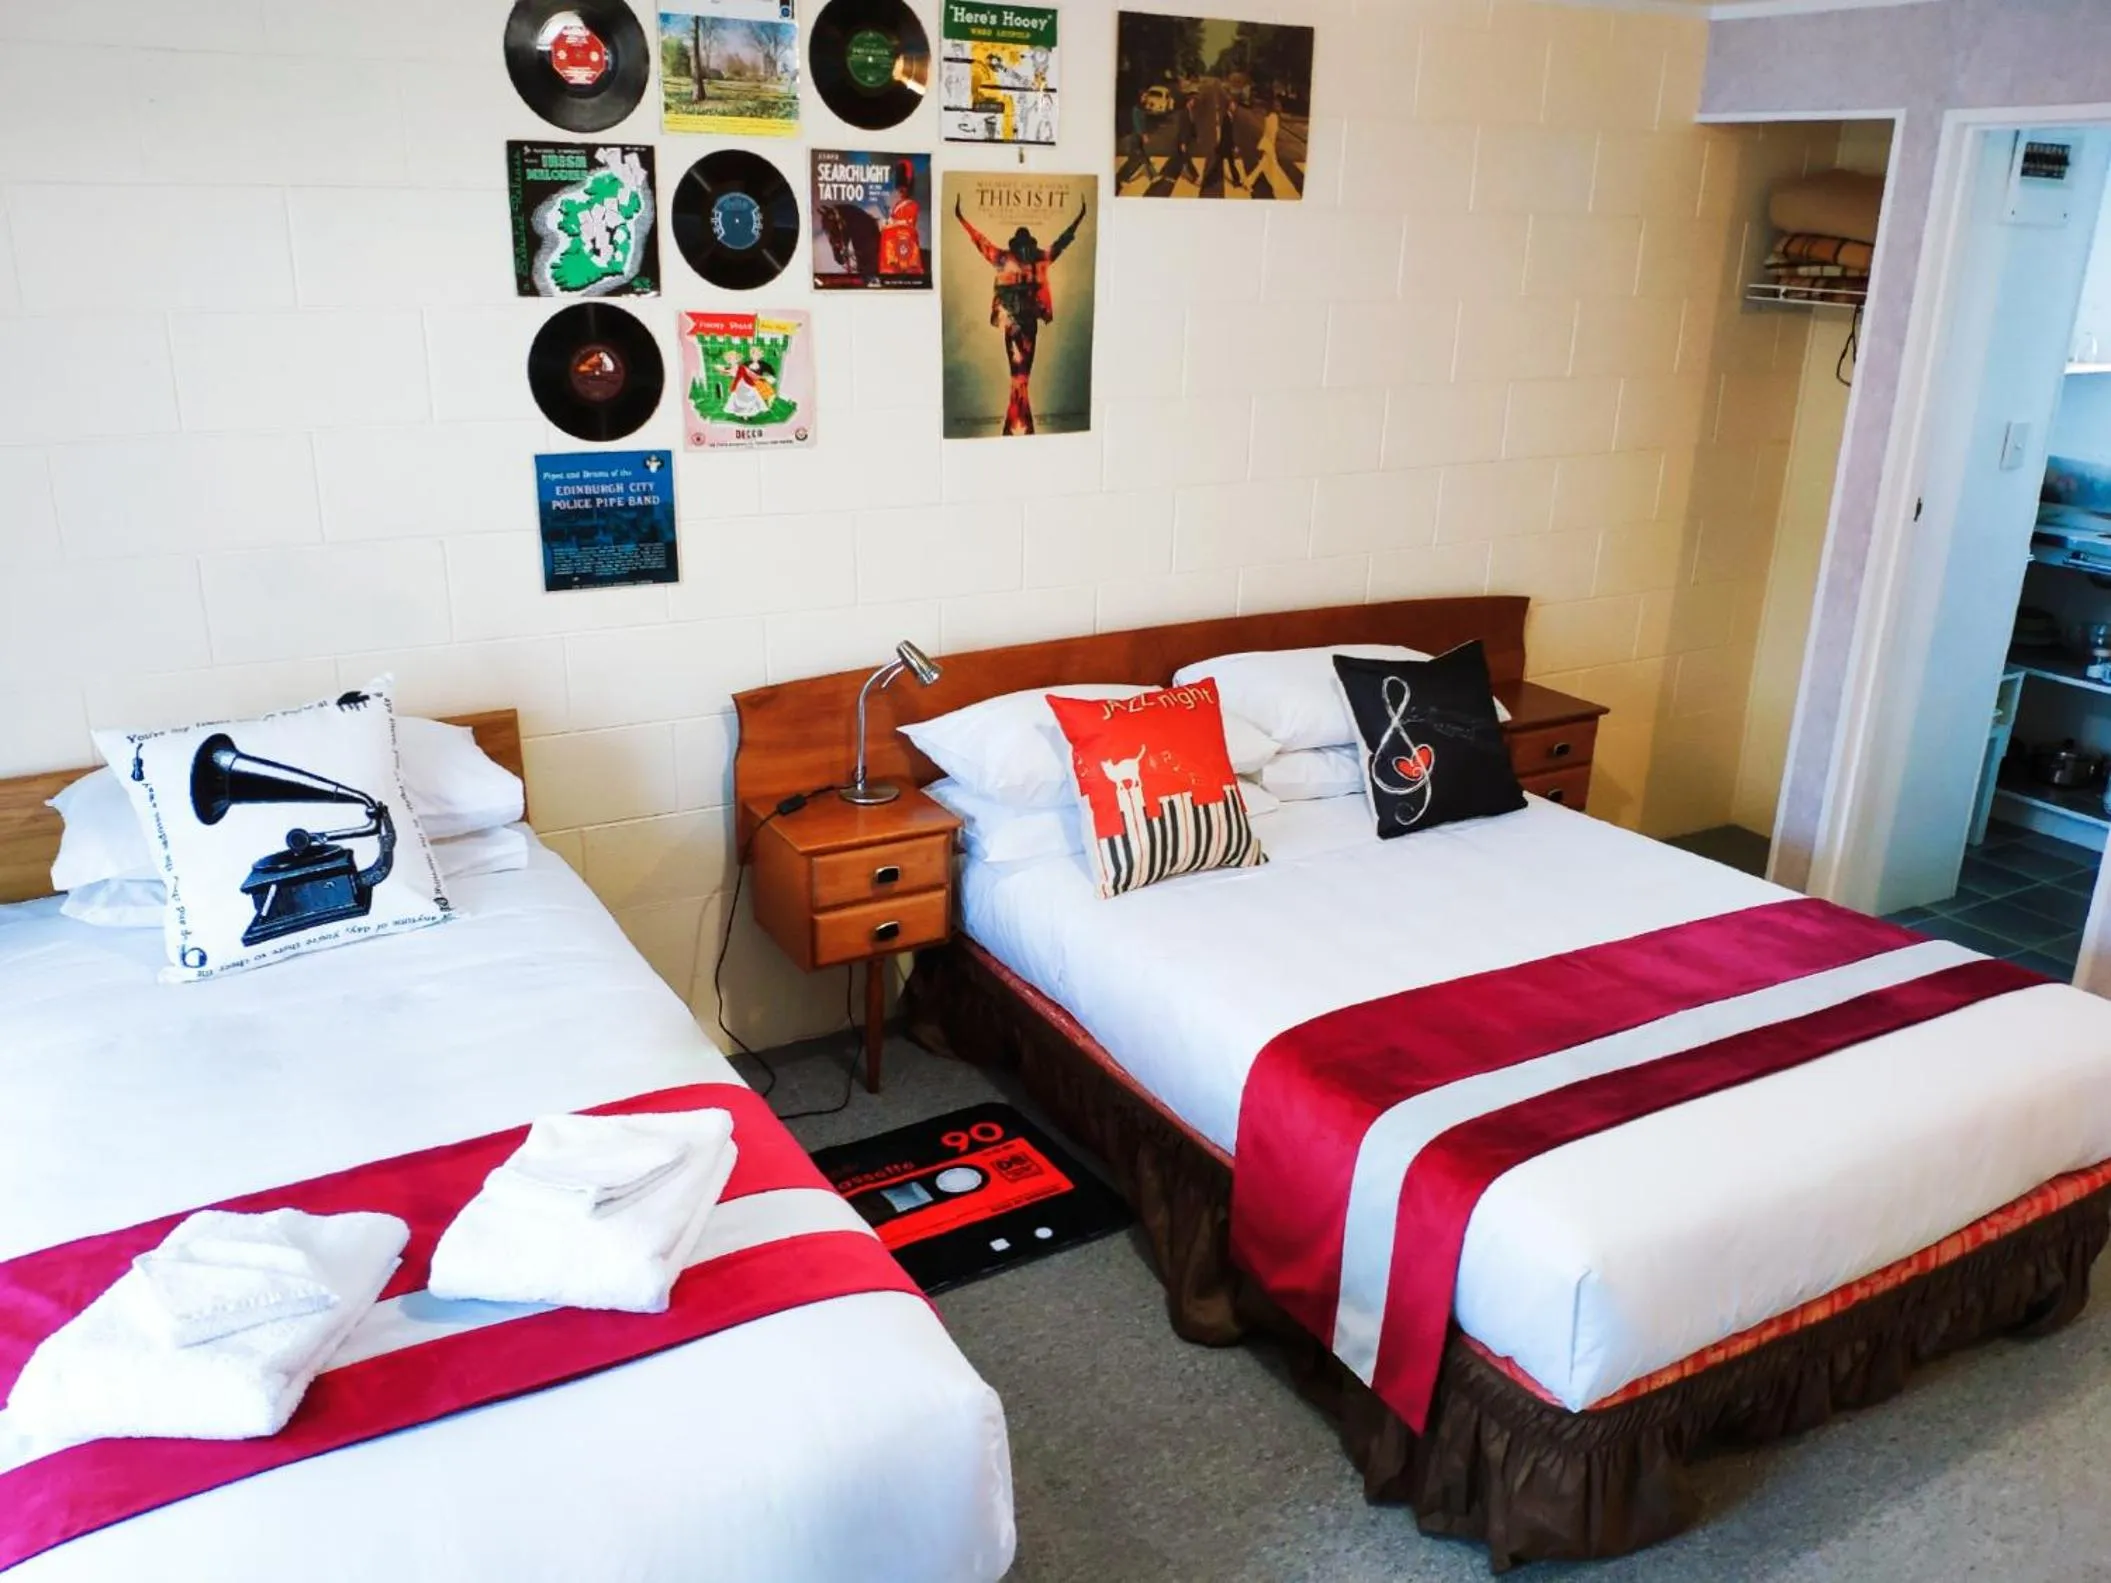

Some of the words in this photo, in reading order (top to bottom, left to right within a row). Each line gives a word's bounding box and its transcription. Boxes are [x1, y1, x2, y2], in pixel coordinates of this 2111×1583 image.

[817, 163, 891, 183] SEARCHLIGHT
[818, 183, 864, 201] TATTOO
[976, 188, 1021, 206] THIS
[1027, 189, 1042, 208] IS
[1048, 190, 1070, 208] IT
[566, 471, 580, 479] and
[611, 468, 620, 477] of
[620, 467, 632, 477] the
[555, 483, 625, 496] EDINBURGH
[629, 481, 656, 493] CITY
[551, 498, 593, 511] POLICE
[596, 496, 625, 508] PIPE
[628, 494, 661, 506] BAND
[1157, 686, 1214, 709] night
[940, 1121, 1004, 1152] 90
[838, 1160, 915, 1190] assette
